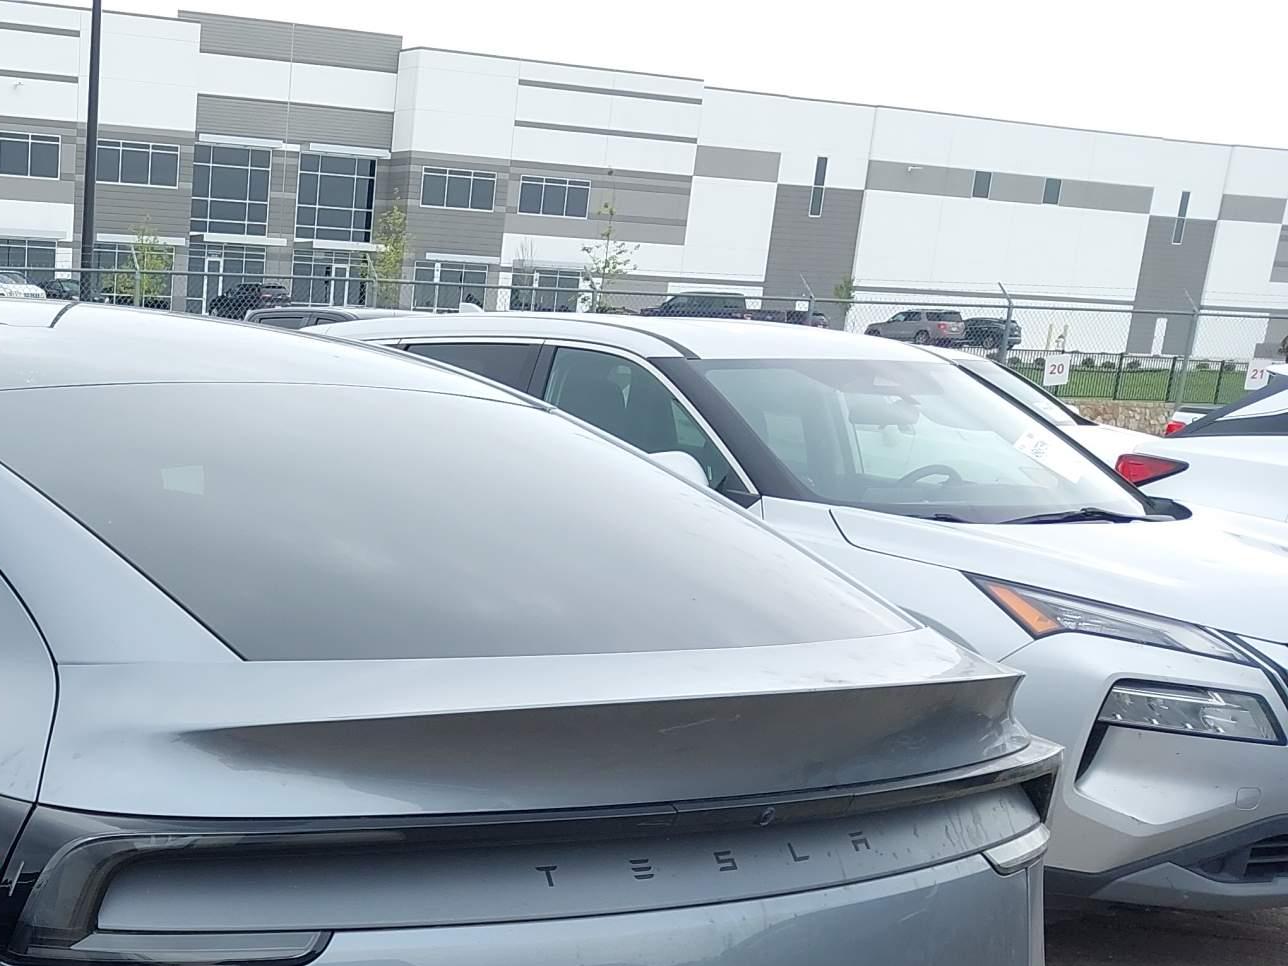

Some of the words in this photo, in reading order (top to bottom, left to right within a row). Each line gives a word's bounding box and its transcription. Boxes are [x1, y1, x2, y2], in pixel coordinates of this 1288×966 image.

[1049, 363, 1065, 374] 20
[1251, 369, 1265, 379] 21
[535, 831, 871, 888] TESLA
